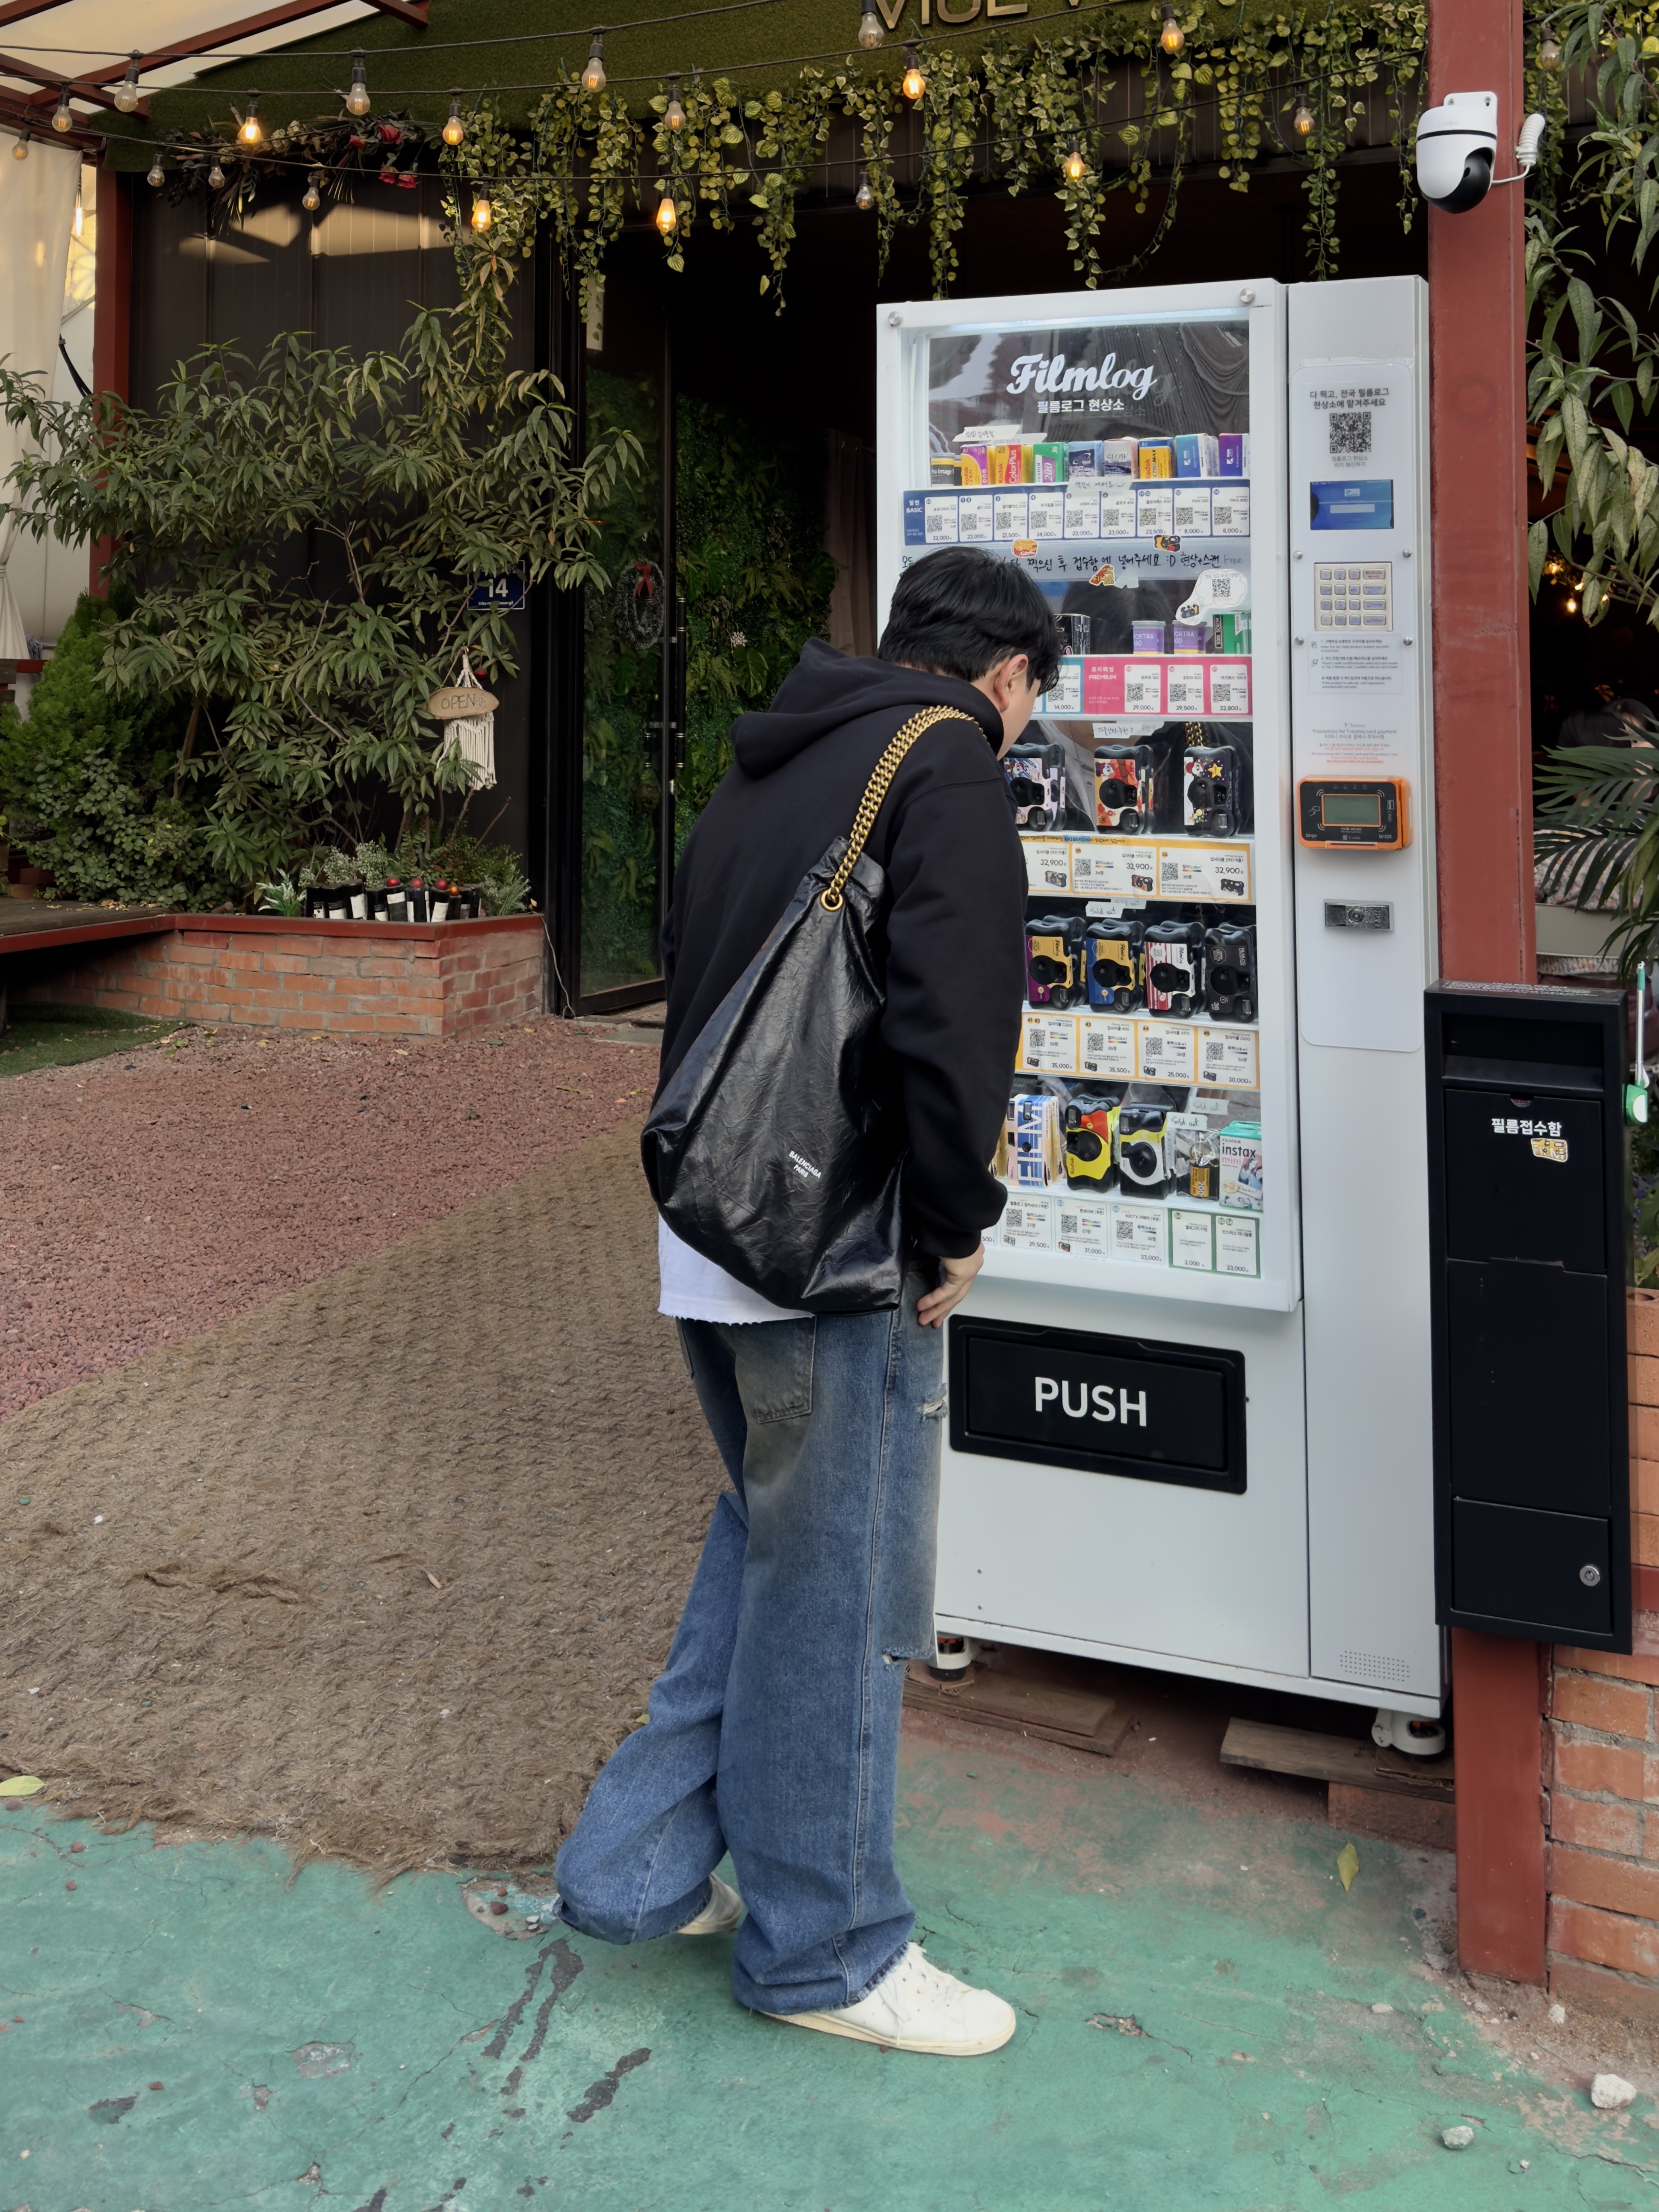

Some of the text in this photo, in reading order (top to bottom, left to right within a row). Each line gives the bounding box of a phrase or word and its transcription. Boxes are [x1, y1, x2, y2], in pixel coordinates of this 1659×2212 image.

[1006, 353, 1157, 401] Filmlog
[1340, 389, 1355, 398] 전국
[1358, 388, 1389, 397] 필름로그
[1038, 398, 1125, 414] 필름로그 현상소
[1313, 398, 1386, 409] 현상소에 맡겨주세요
[1044, 462, 1053, 482] 200
[1058, 556, 1068, 572] 후
[1072, 556, 1098, 572] 접수함
[1118, 553, 1162, 571] 넣어주세요
[1223, 556, 1244, 565] Free
[488, 578, 509, 597] 14
[441, 694, 476, 710] OPEN
[1215, 866, 1240, 875] 32,900
[1090, 906, 1116, 915] Sold out
[1214, 1002, 1219, 1011] 36
[1171, 1117, 1199, 1127] Sold out
[1491, 1118, 1562, 1137] 필름접수함
[1222, 1143, 1257, 1158] instax
[788, 1150, 822, 1179] BALENCIAGA
[1222, 1156, 1240, 1165] mini
[793, 1164, 809, 1178] PARIS
[1035, 1376, 1147, 1427] PUSH
